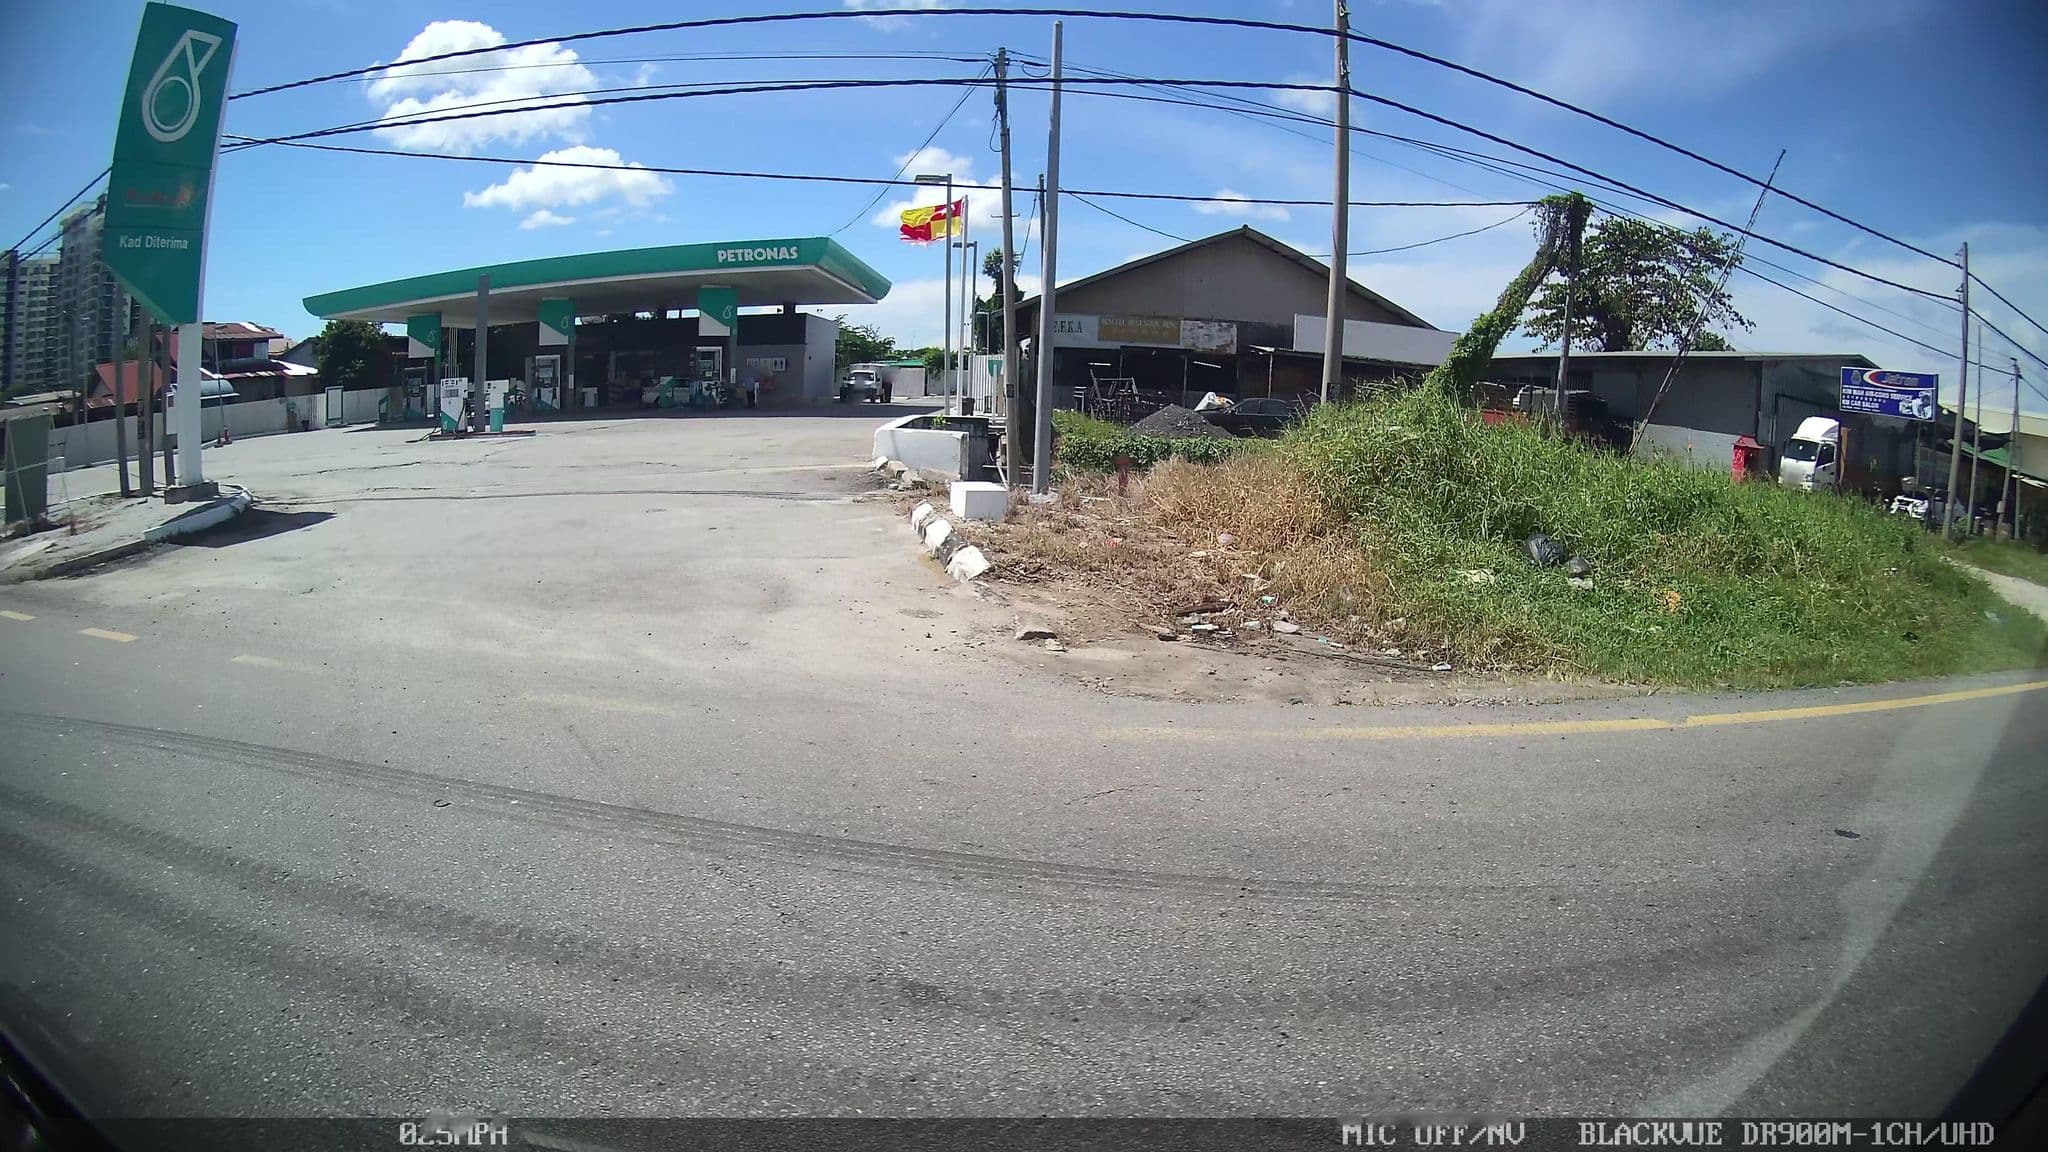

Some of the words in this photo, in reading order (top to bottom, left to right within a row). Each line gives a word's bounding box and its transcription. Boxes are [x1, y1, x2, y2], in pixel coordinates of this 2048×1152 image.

[119, 234, 142, 248] Kad
[145, 235, 188, 249] Diterima
[717, 246, 798, 262] PETRONAS
